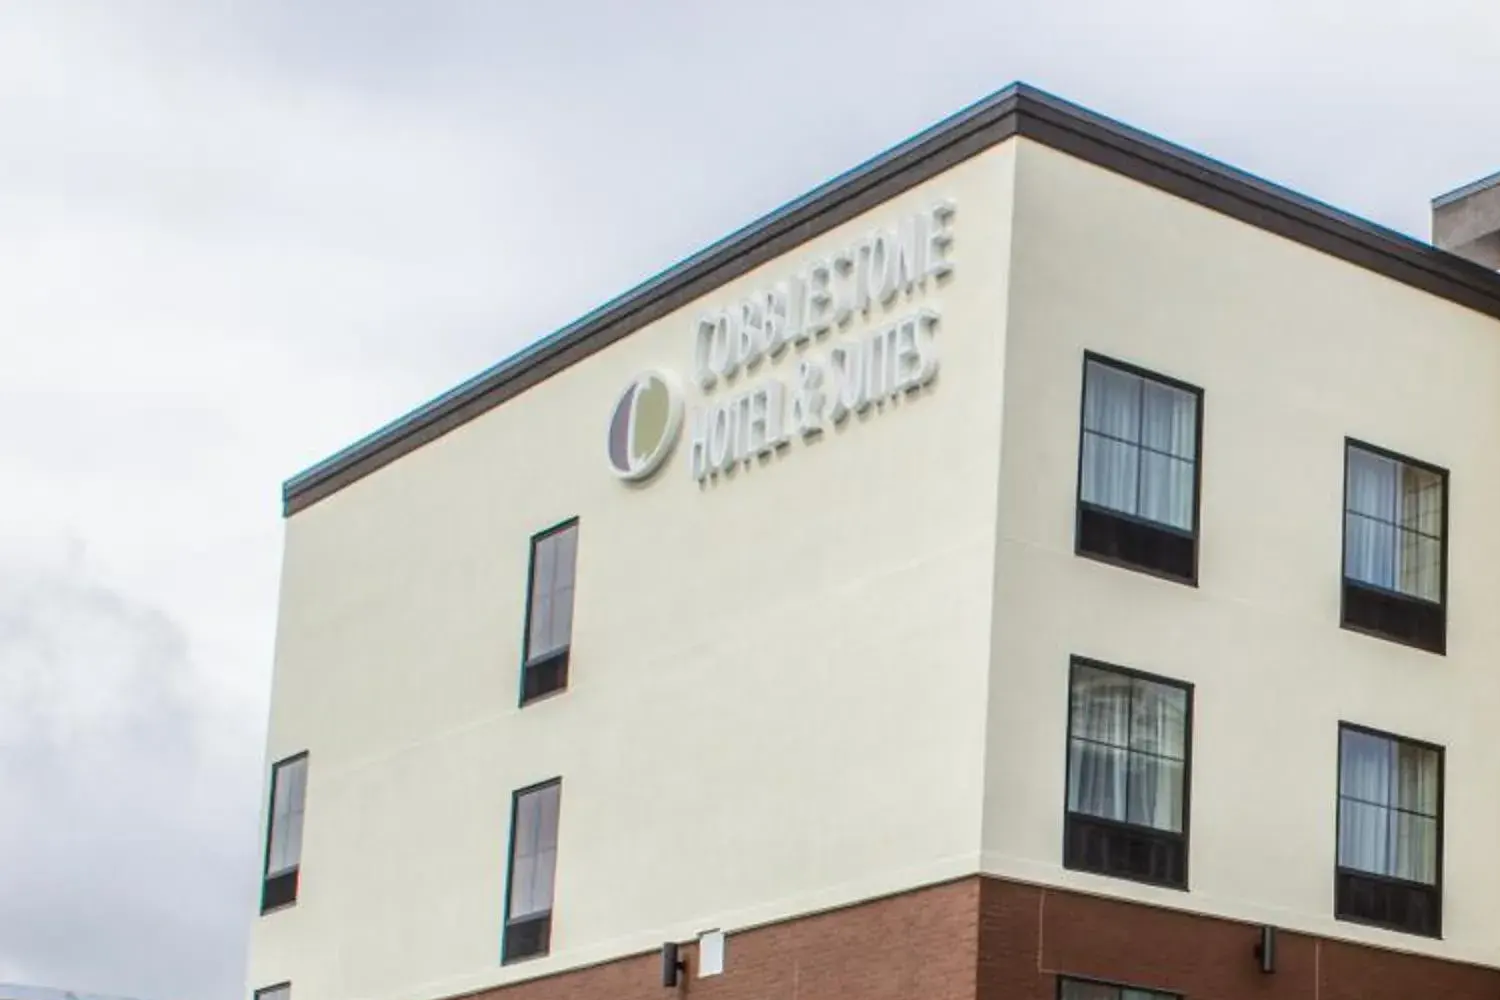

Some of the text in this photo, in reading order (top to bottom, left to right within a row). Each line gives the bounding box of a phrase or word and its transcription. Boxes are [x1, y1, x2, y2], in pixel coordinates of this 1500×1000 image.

[692, 199, 957, 393] COBBLESTONE
[690, 306, 941, 490] HOTEL & SUITES
